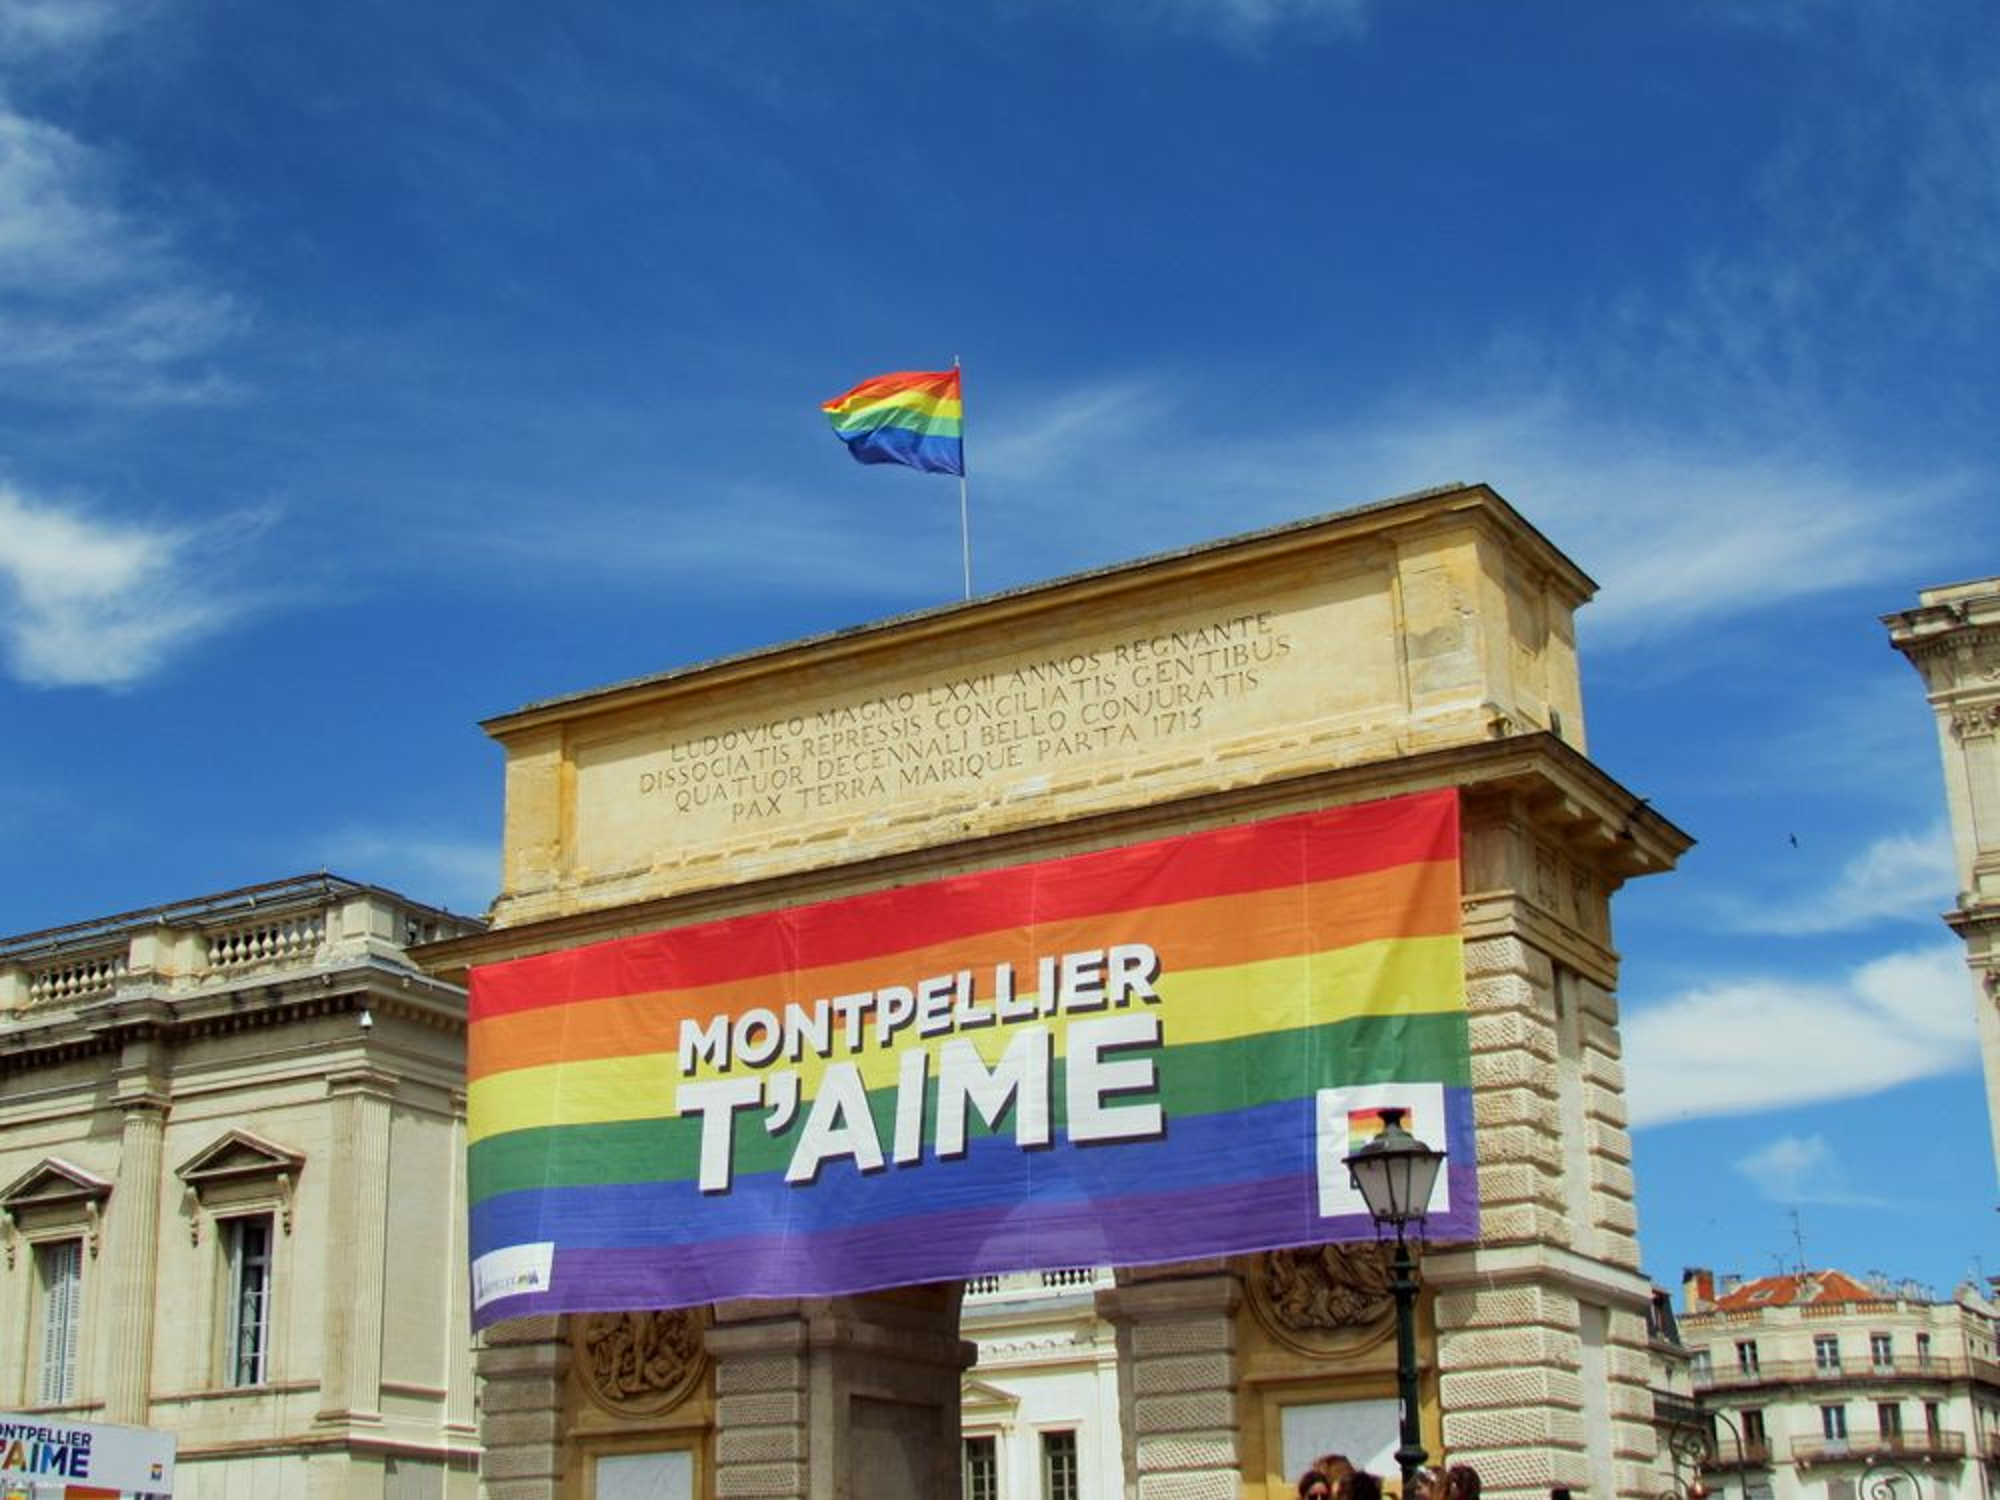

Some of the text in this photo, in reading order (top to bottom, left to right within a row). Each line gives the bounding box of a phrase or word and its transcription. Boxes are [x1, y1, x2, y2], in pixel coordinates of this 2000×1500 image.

[639, 633, 1291, 794] DISSOCIATIS REPRESSIS CONCILIATIS GENTIBUS
[670, 611, 1273, 763] LUDOVICO MAGNO LXXII ANNOS REGNANTE
[675, 669, 1260, 813] QUATUOR DECENNALI BELLO CONJURATIS
[732, 706, 1202, 823] PAX TERRA MARIQUE PARTA 1715
[678, 943, 1162, 1076] MONTPELLIER
